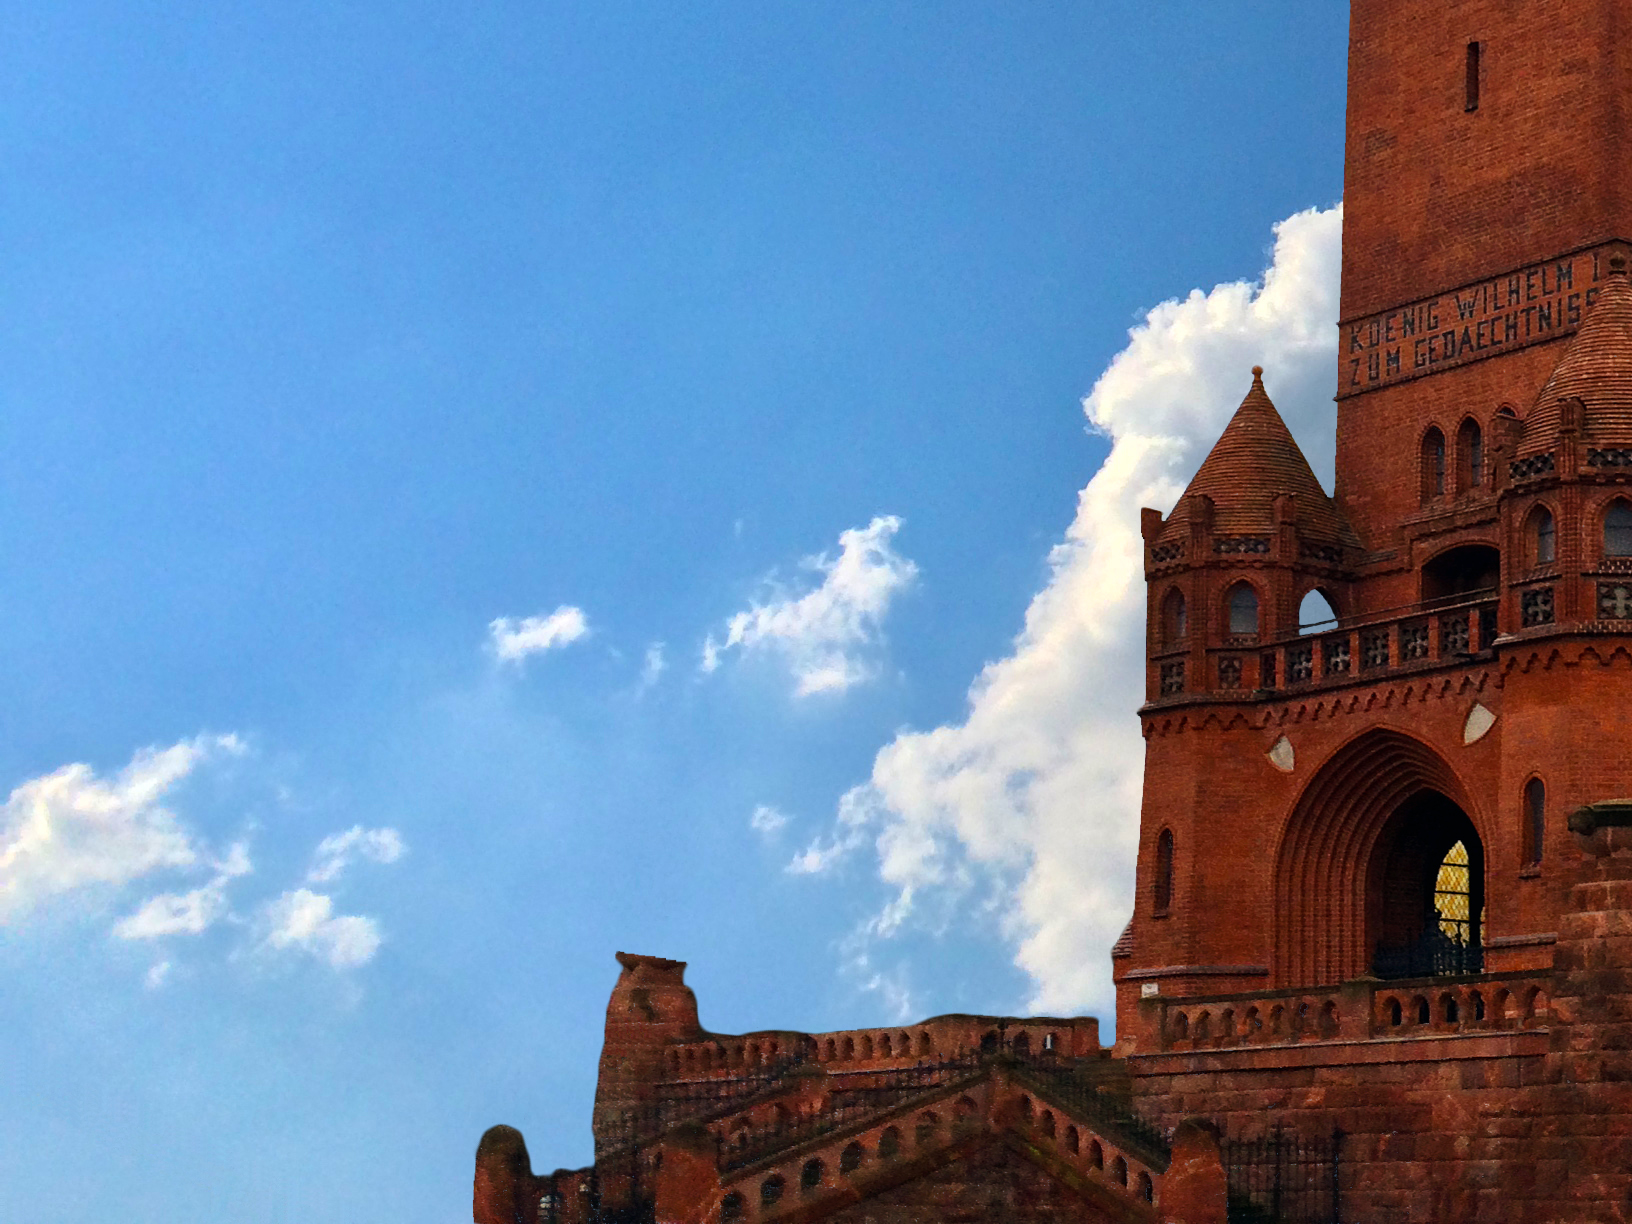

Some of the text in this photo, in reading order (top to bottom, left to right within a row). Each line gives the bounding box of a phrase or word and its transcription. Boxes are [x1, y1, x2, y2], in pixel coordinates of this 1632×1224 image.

[1349, 300, 1439, 354] KOENIG
[1455, 260, 1573, 320] WILHELM
[1350, 345, 1402, 387] ZUM
